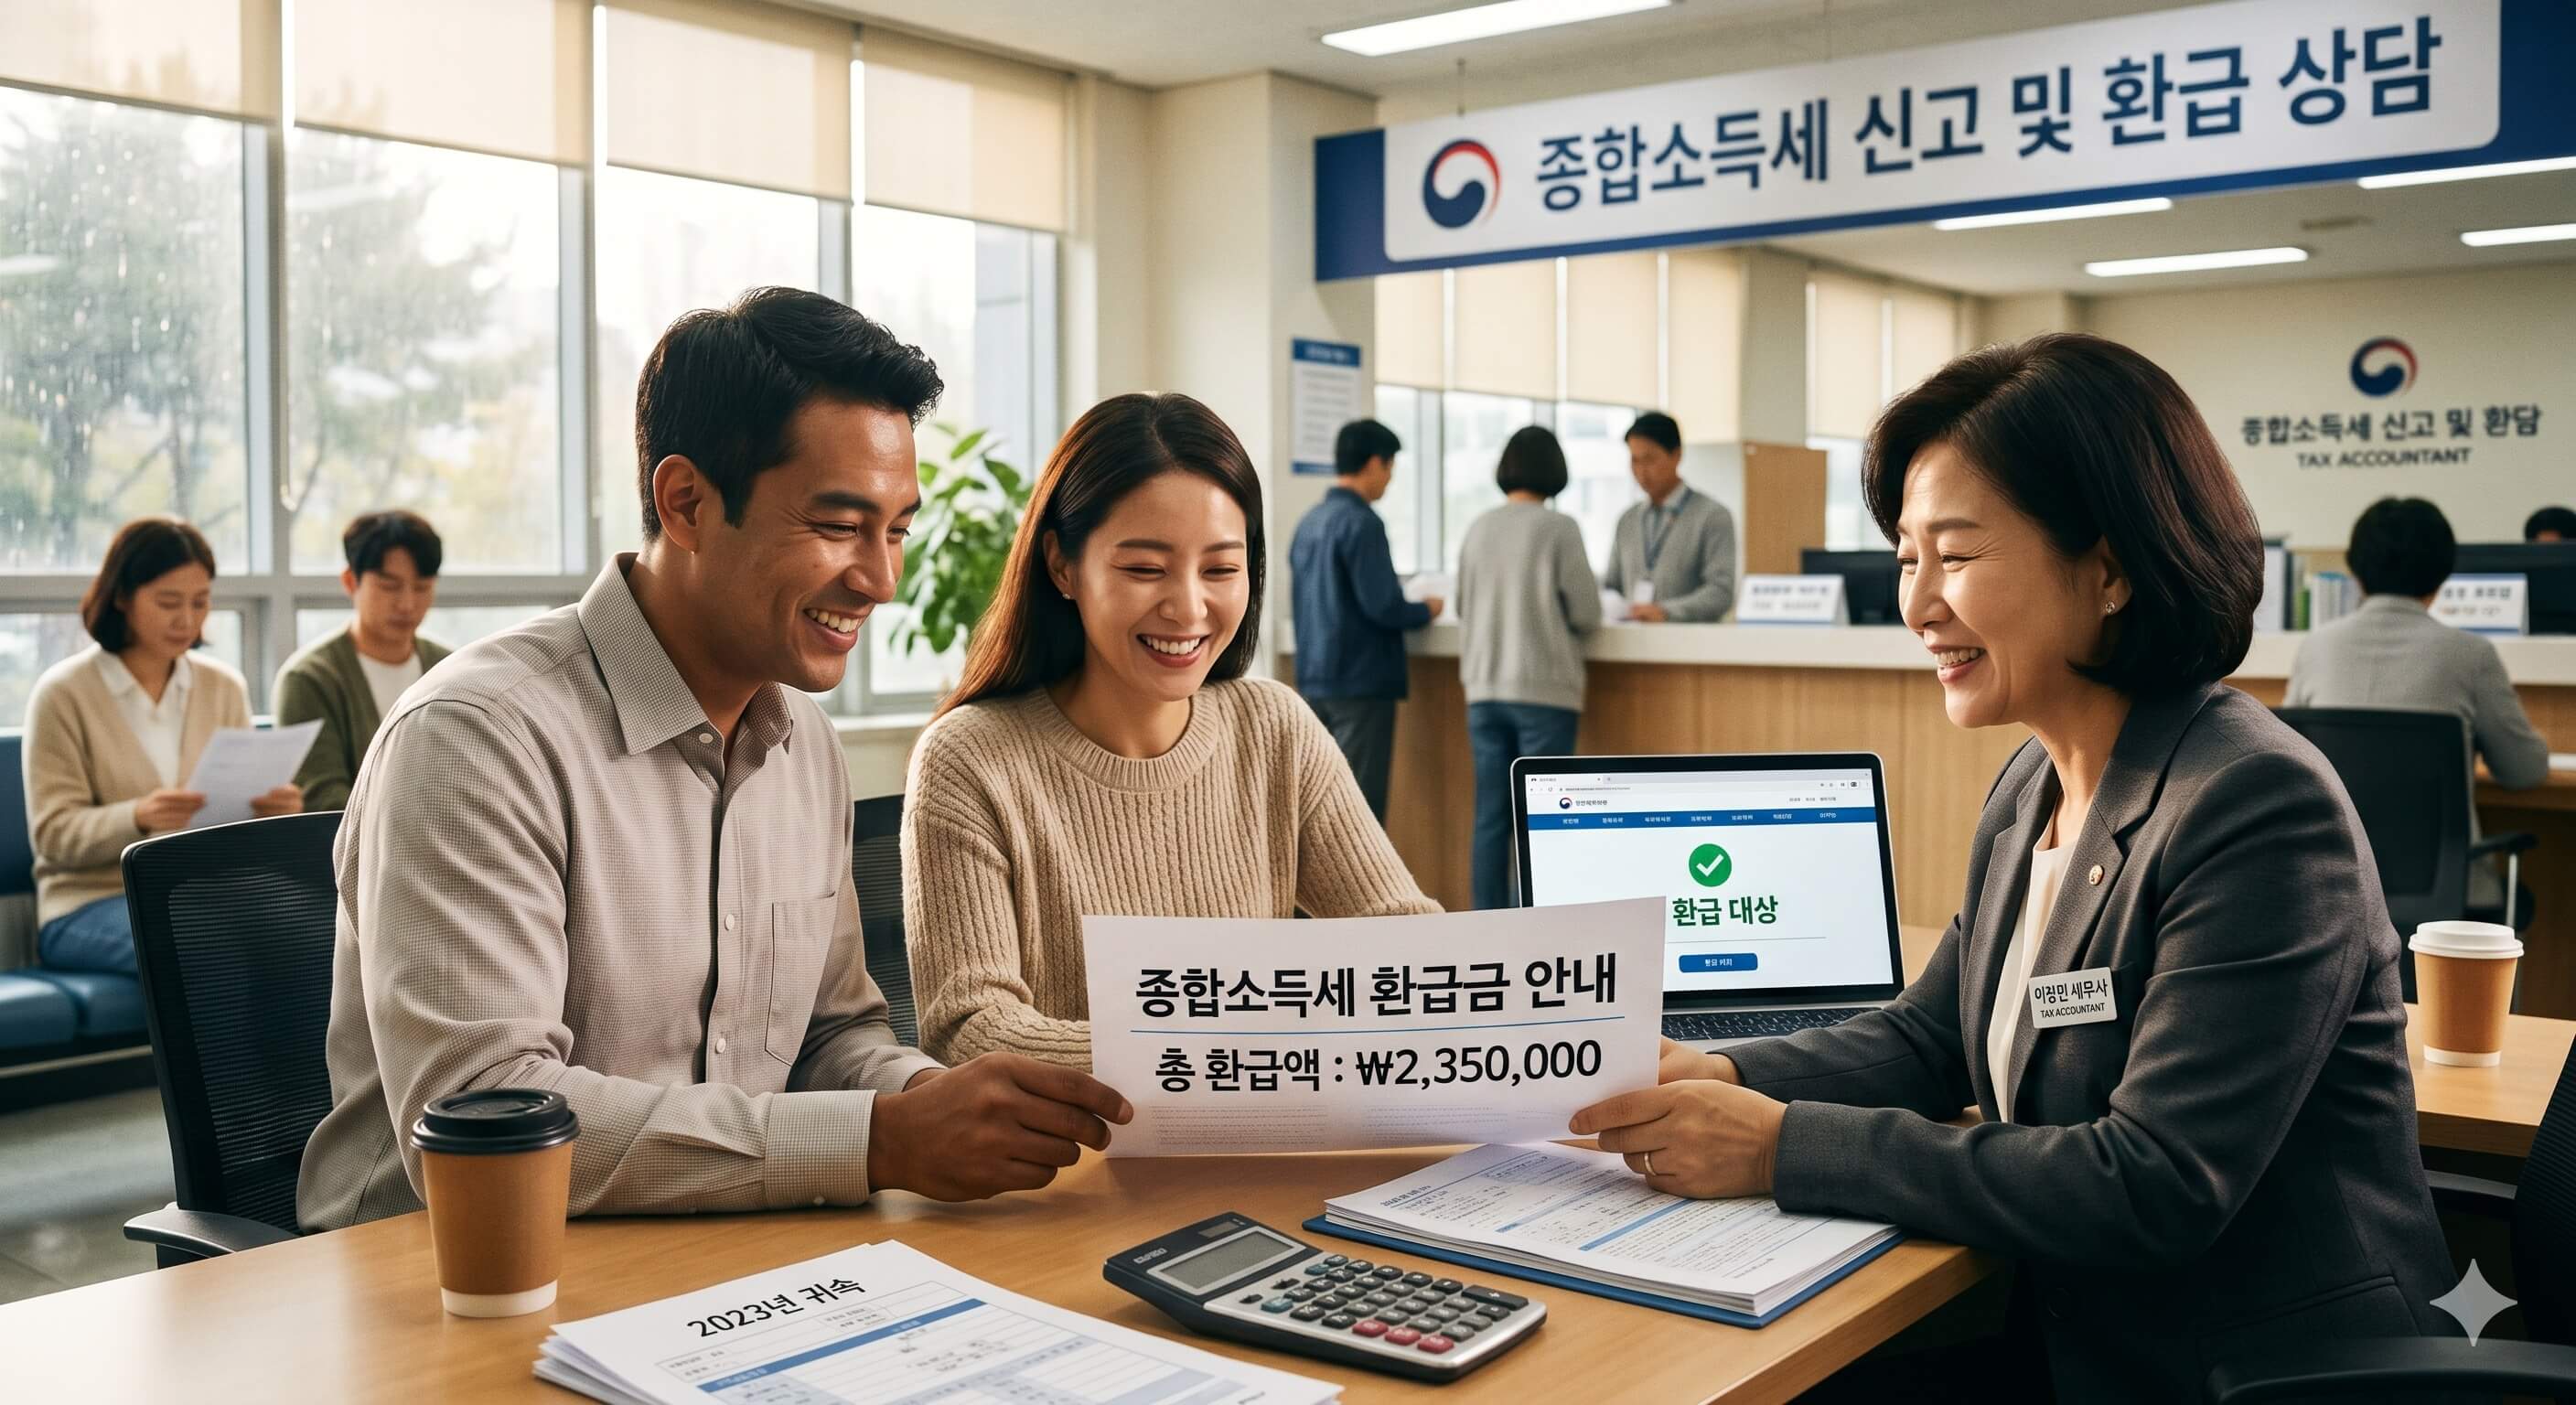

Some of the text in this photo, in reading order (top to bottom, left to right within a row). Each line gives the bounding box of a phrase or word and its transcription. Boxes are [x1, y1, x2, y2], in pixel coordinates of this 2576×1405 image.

[1537, 15, 2442, 211] 종합소득세 신고 및 환급 상담
[2242, 413, 2372, 446] 종합소득세
[2381, 411, 2435, 442] 신고
[2446, 408, 2472, 438] 및
[2297, 446, 2472, 468] TAX ACCOUNTANT
[1672, 896, 1778, 927] 환급 대상
[1136, 953, 1615, 1018] 종합소득세 환급금 안내
[2071, 979, 2108, 1000] 세무사
[2041, 1003, 2105, 1018] TAX ACCOUNTANT
[1155, 1048, 1196, 1092] 총
[1206, 1049, 1319, 1091] 환급액
[1356, 1040, 1601, 1089] ₩2,350,000
[687, 1294, 804, 1337] 2023년
[798, 1280, 865, 1303] 귀속
